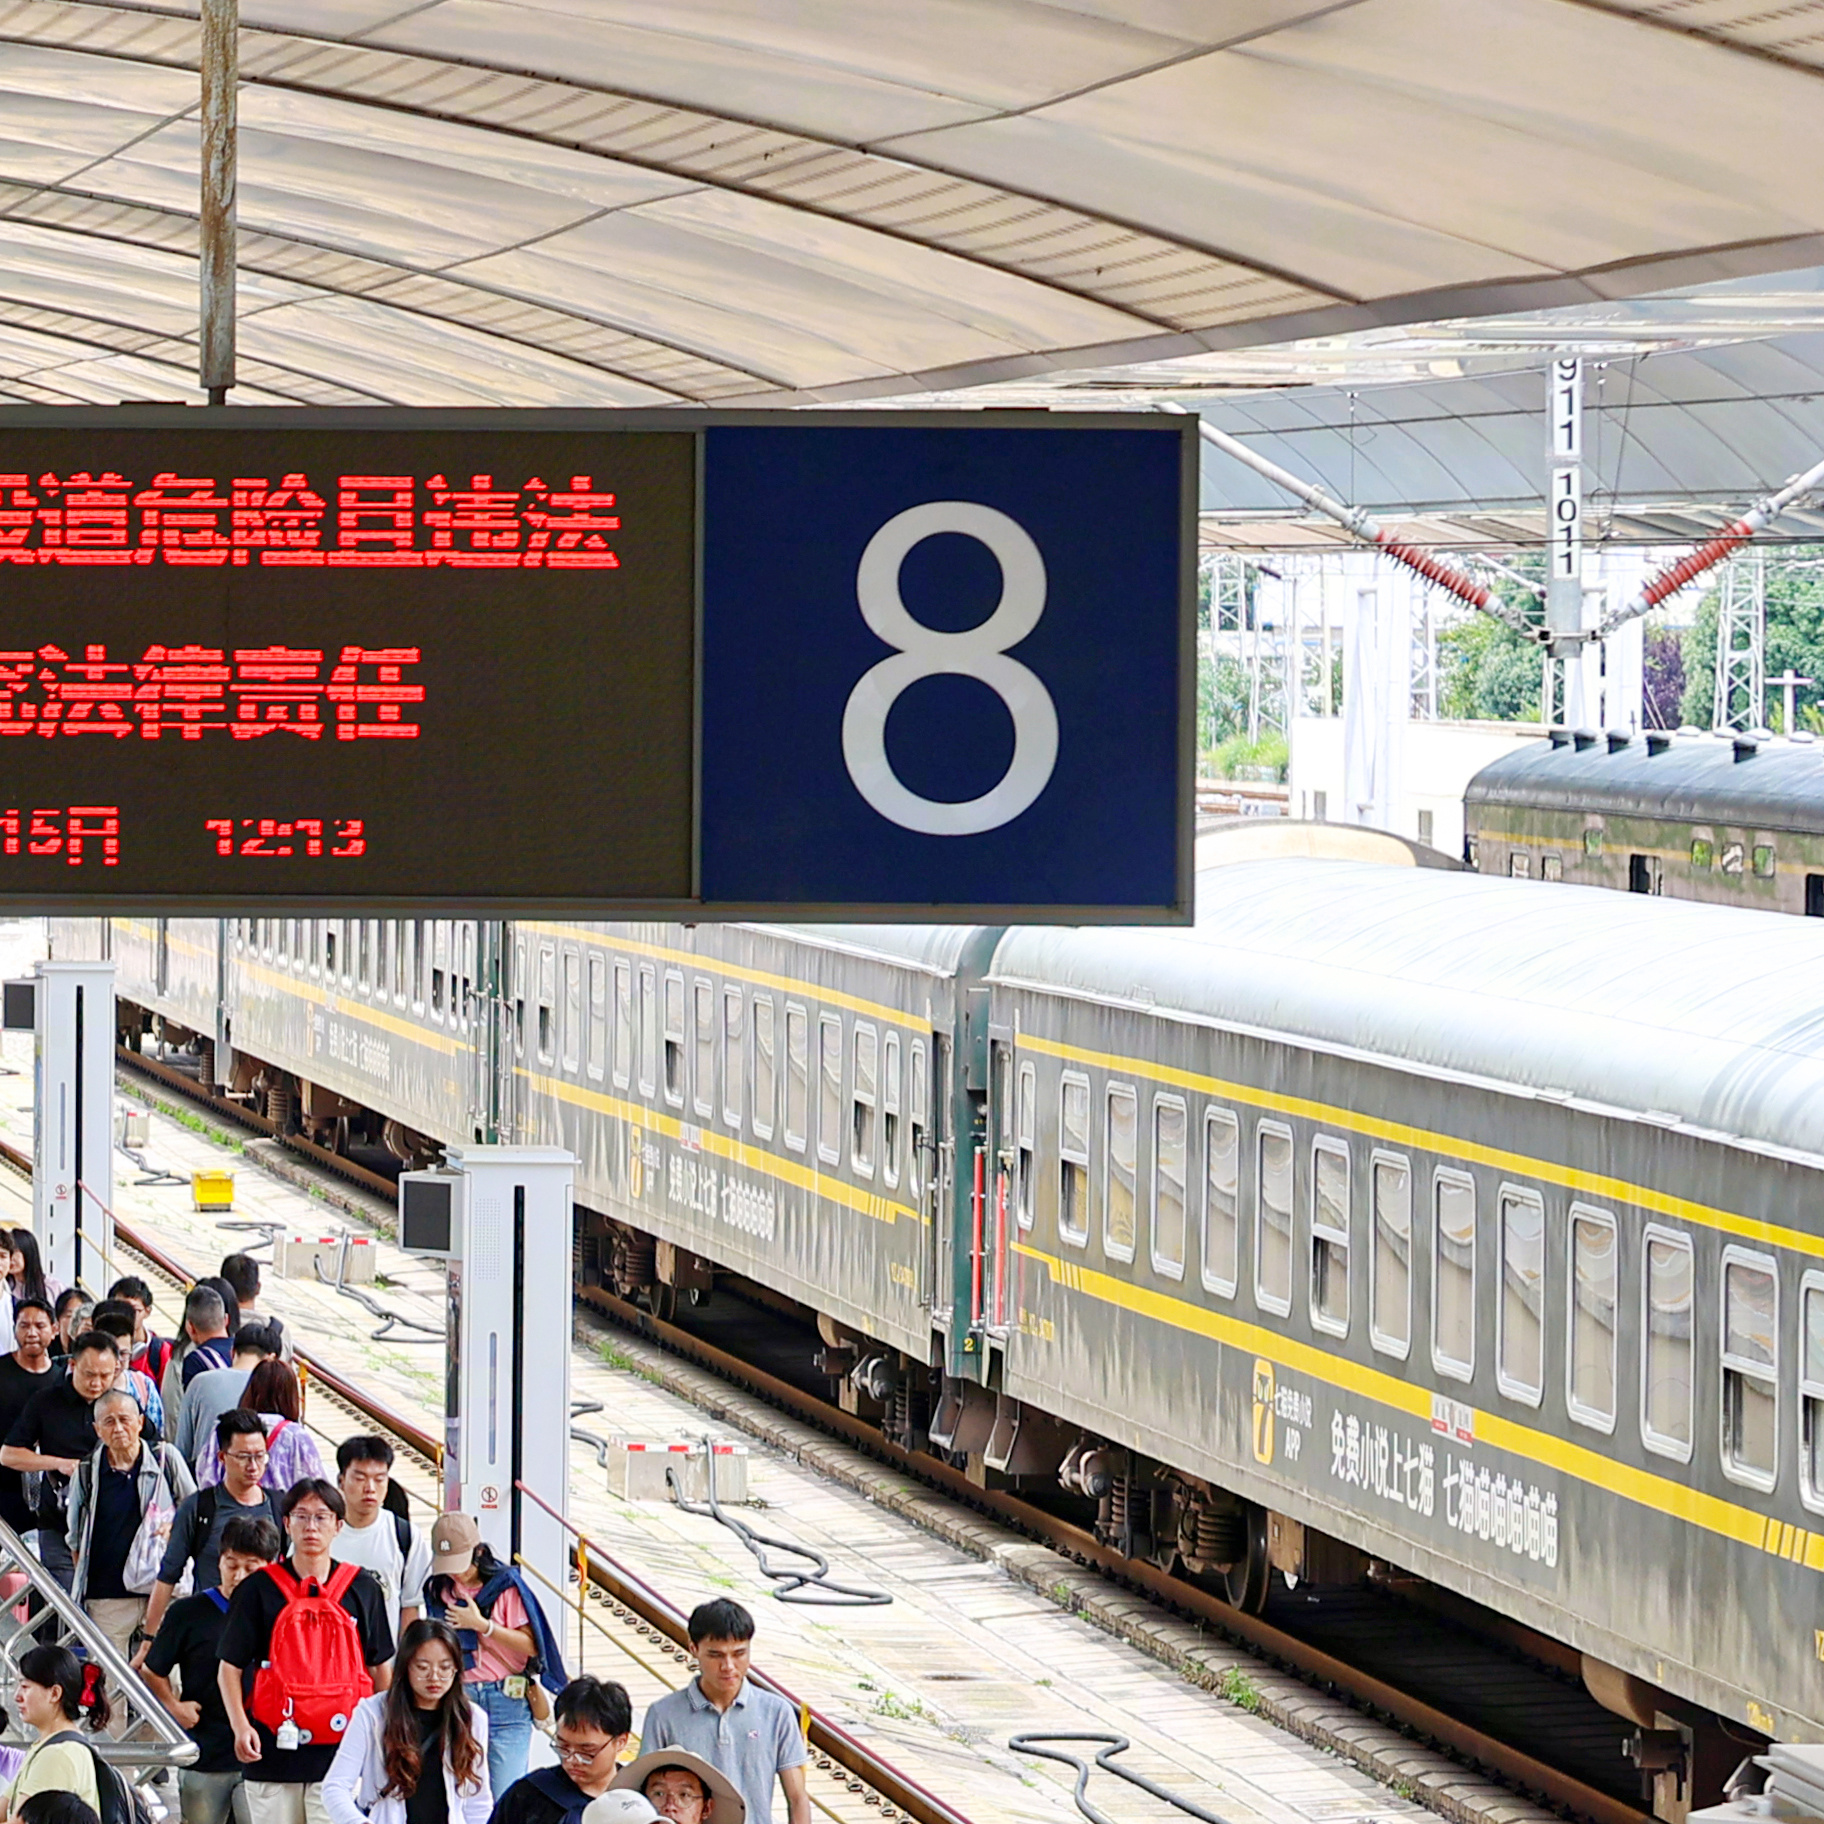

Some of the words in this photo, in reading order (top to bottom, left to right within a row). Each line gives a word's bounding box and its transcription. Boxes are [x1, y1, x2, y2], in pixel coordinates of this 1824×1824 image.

[842, 501, 1059, 836] 8
[205, 818, 367, 857] 12:13
[963, 1337, 973, 1351] 2
[1284, 1427, 1301, 1462] APP
[1330, 1408, 1435, 1518] 免费小说上七猫
[1442, 1452, 1558, 1569] 七猫喵喵喵喵喵
